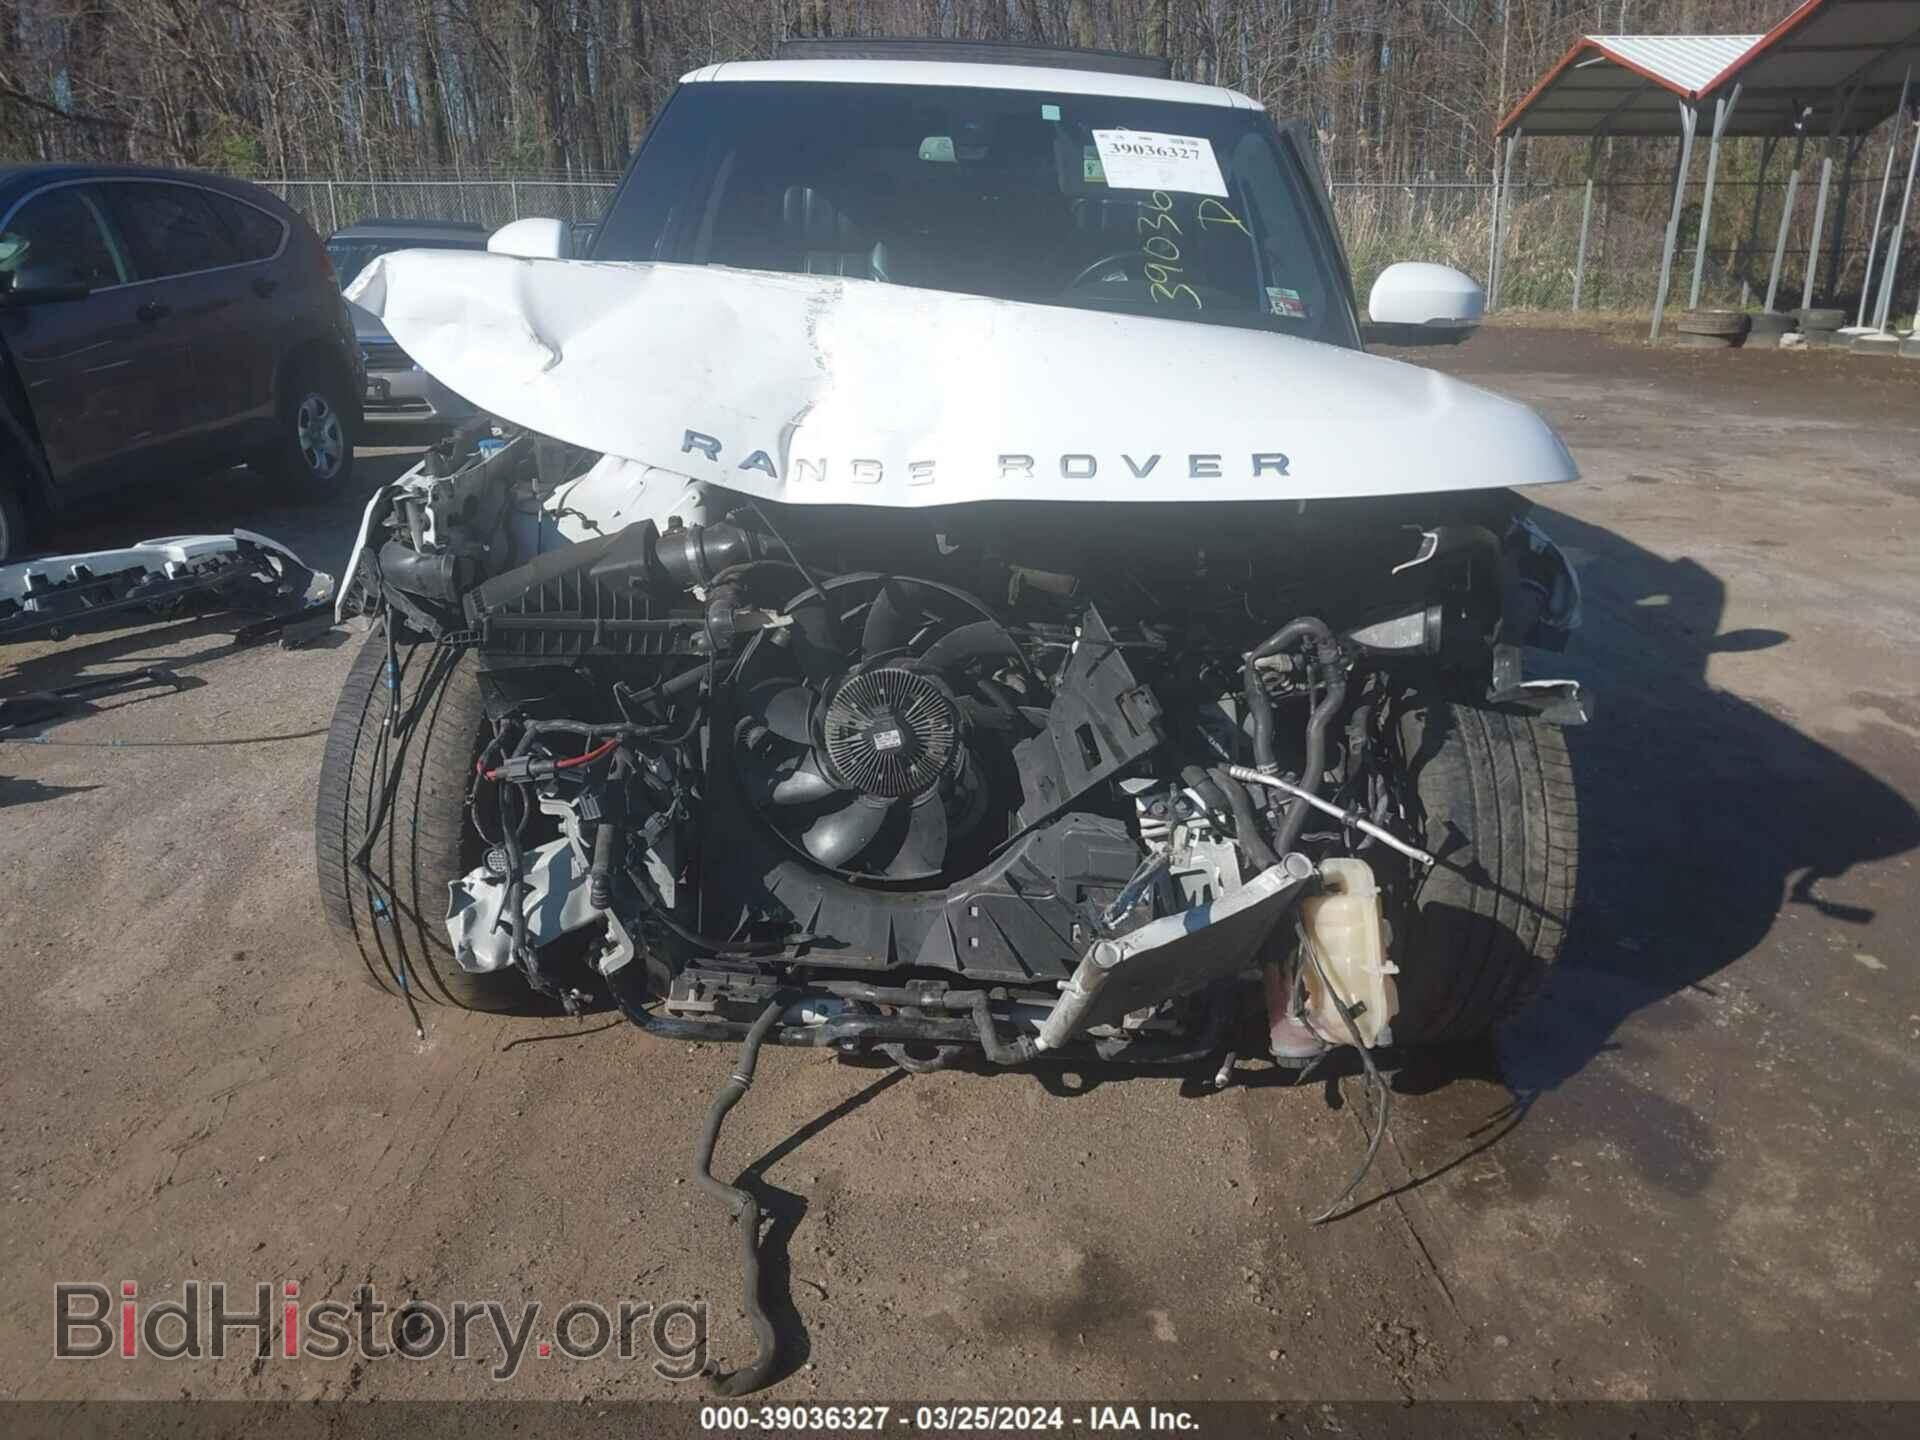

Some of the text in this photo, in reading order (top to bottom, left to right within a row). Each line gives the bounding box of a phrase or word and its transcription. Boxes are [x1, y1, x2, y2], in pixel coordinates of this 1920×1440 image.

[1109, 142, 1199, 161] 39036327
[680, 429, 1291, 486] RANGE ROVER
